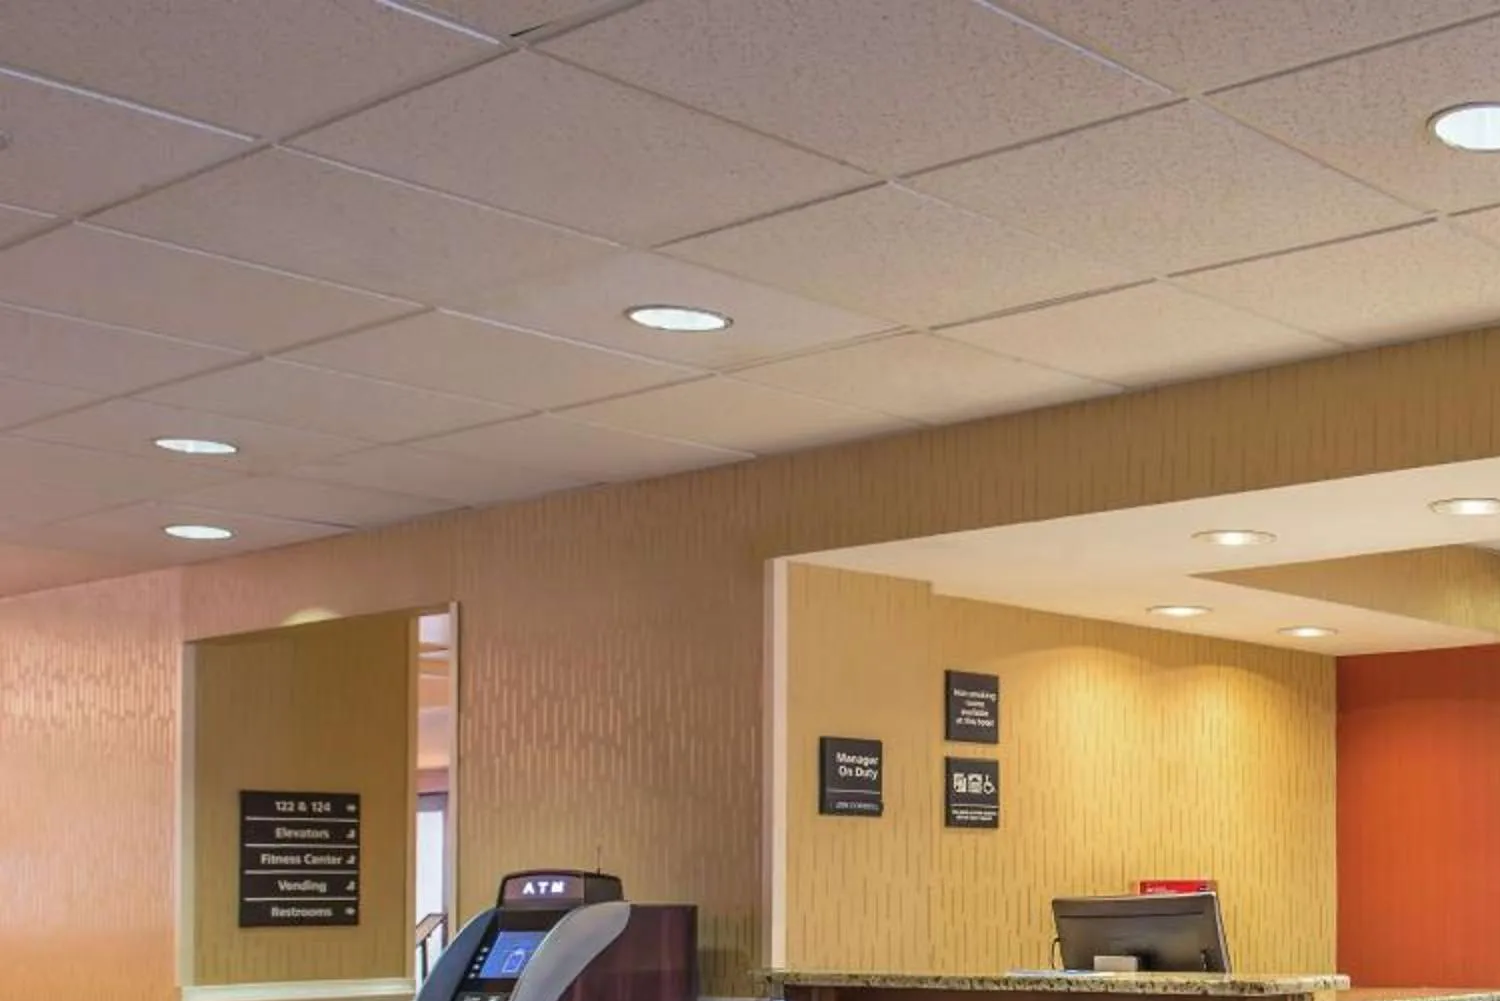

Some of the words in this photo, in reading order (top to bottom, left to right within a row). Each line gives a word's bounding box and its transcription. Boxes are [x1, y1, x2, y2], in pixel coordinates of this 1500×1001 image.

[836, 751, 879, 767] Manager
[839, 765, 853, 777] On
[855, 766, 878, 781] Duty
[275, 801, 295, 811] 122
[297, 801, 307, 812] &
[311, 802, 331, 813] 124
[275, 828, 330, 839] Elevators
[260, 853, 301, 865] Fitness
[303, 853, 342, 865] Center
[277, 879, 327, 893] Vending
[522, 880, 563, 895] ATM
[271, 906, 332, 917] Restrooms
